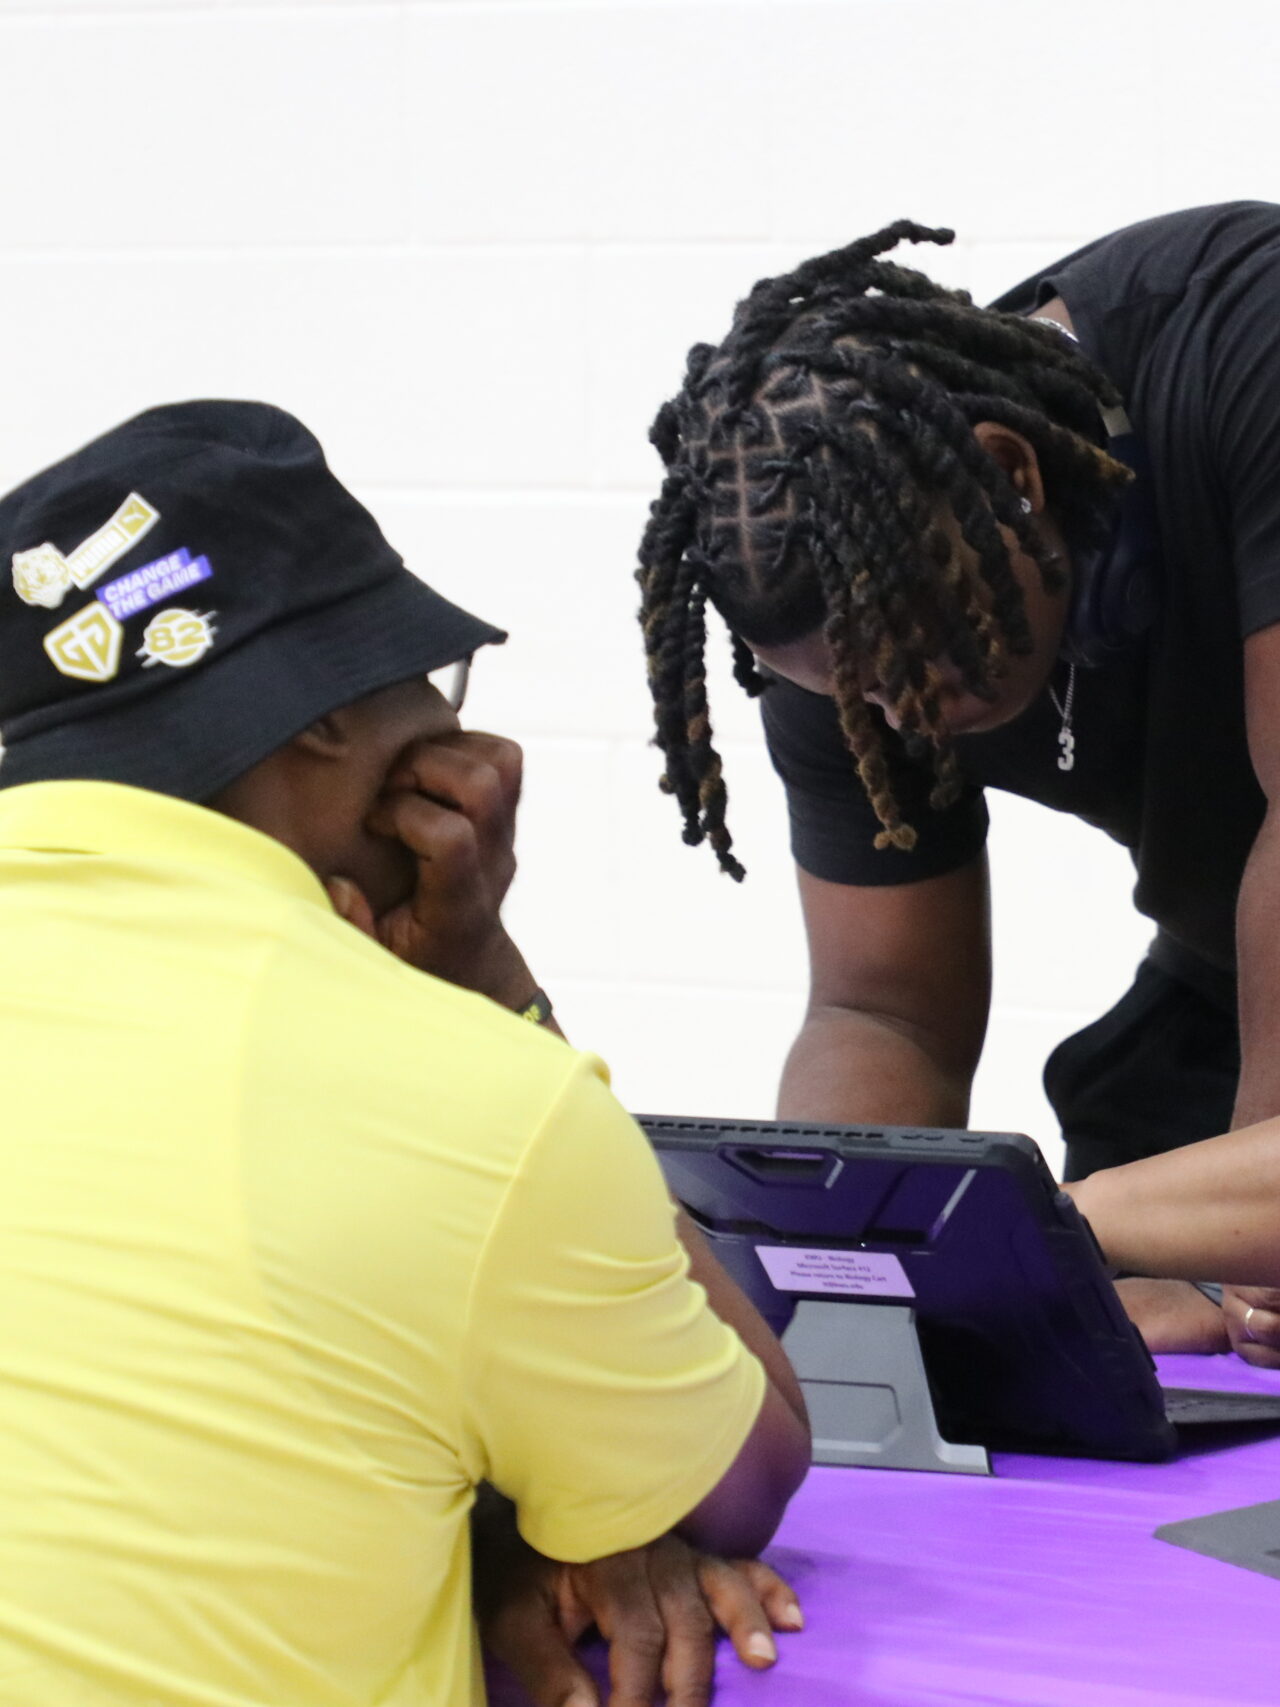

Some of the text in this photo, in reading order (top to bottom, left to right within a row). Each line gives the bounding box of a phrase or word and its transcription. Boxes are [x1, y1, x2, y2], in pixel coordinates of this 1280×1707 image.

[104, 553, 182, 603] CHANGE
[109, 561, 201, 618] THE GAME
[150, 620, 206, 654] 82
[1057, 730, 1075, 771] 3
[796, 1262, 829, 1270] Microsoft
